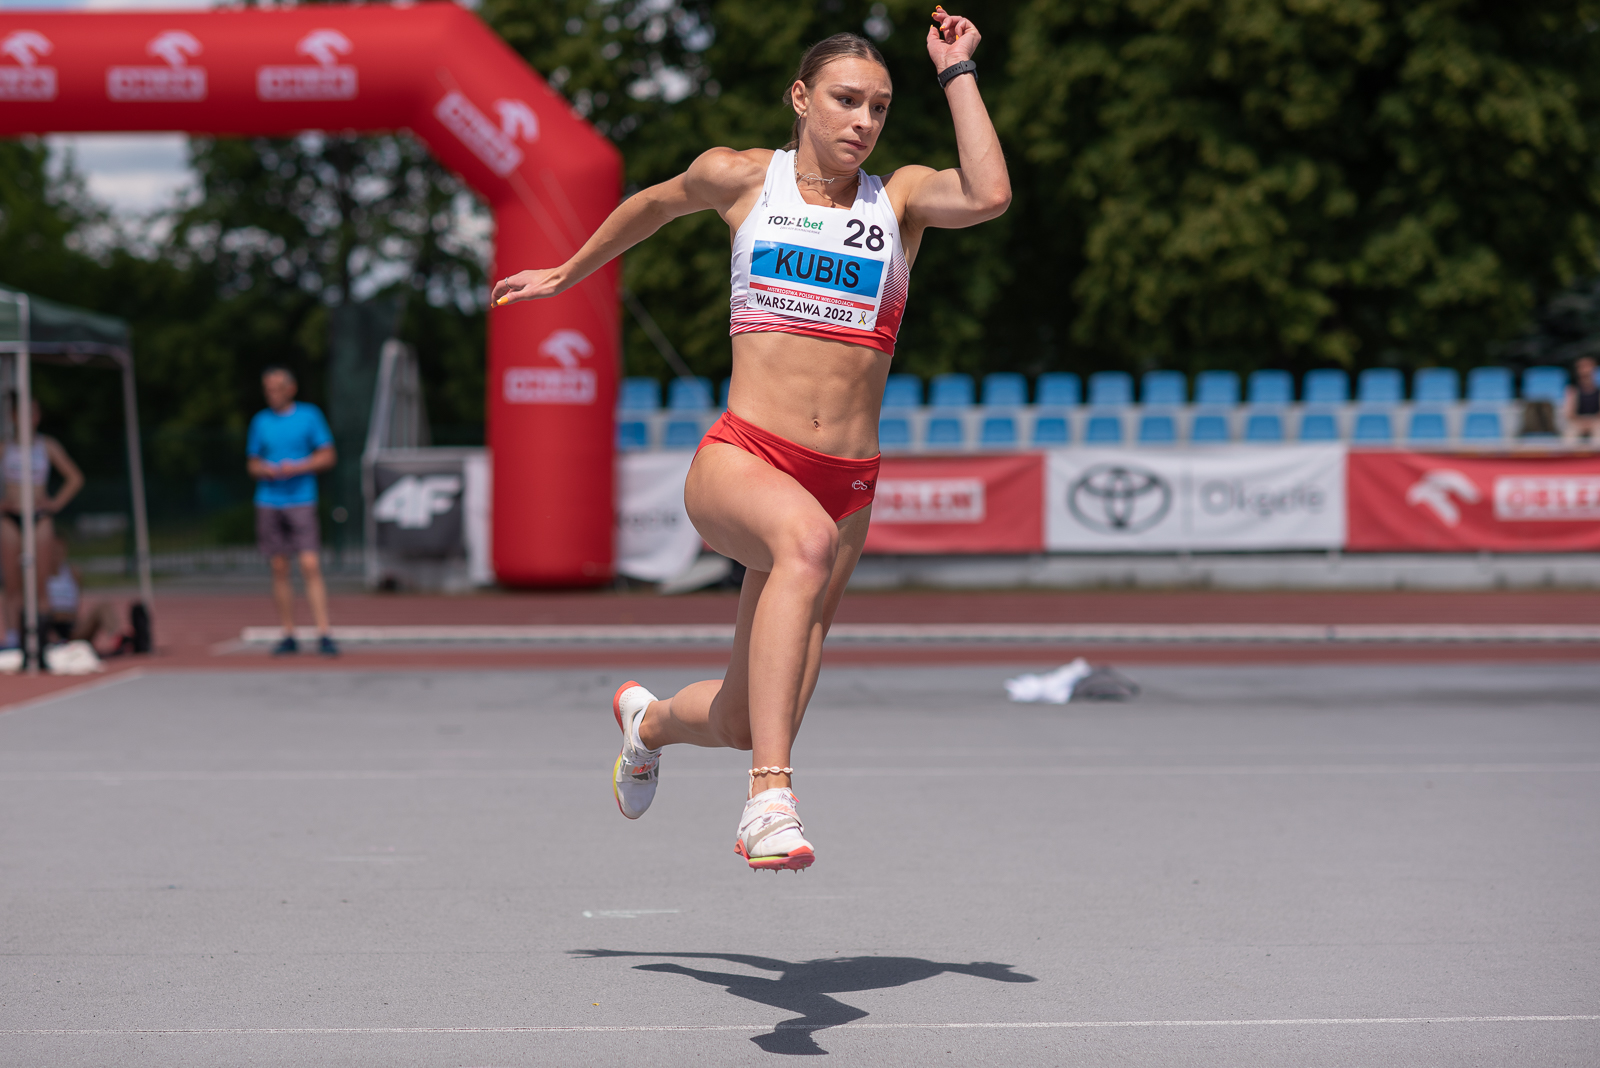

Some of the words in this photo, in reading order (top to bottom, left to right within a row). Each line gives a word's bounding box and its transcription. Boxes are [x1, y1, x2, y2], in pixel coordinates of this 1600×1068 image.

[843, 218, 885, 252] 28
[774, 247, 861, 289] KUBIS
[755, 292, 820, 317] WARSZAWA
[823, 306, 853, 323] 2022
[767, 286, 798, 297] MISTRZOSTWA
[799, 292, 815, 300] POLSKI
[372, 474, 461, 528] 4F
